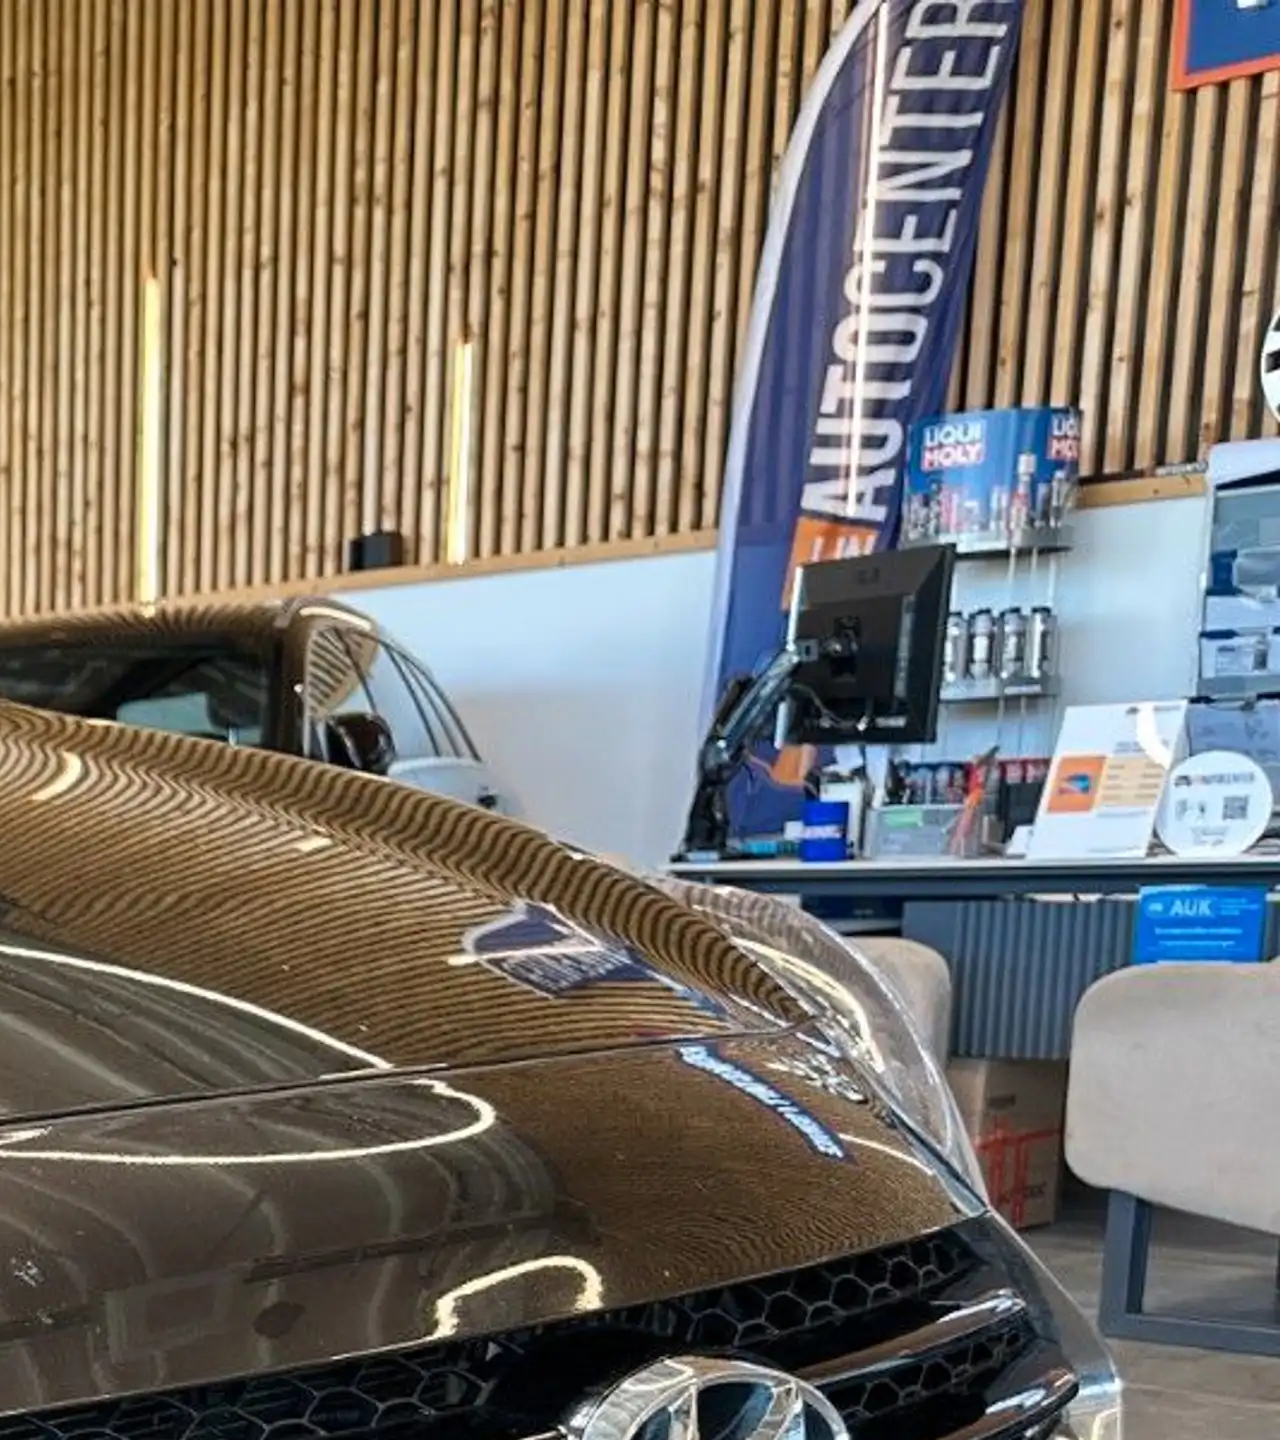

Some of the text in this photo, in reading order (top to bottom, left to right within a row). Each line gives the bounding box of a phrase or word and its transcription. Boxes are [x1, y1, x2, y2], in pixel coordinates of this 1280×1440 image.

[801, 0, 1015, 523] AUTOCENTER
[924, 420, 983, 447] LIQUI
[922, 443, 984, 471] MOLY
